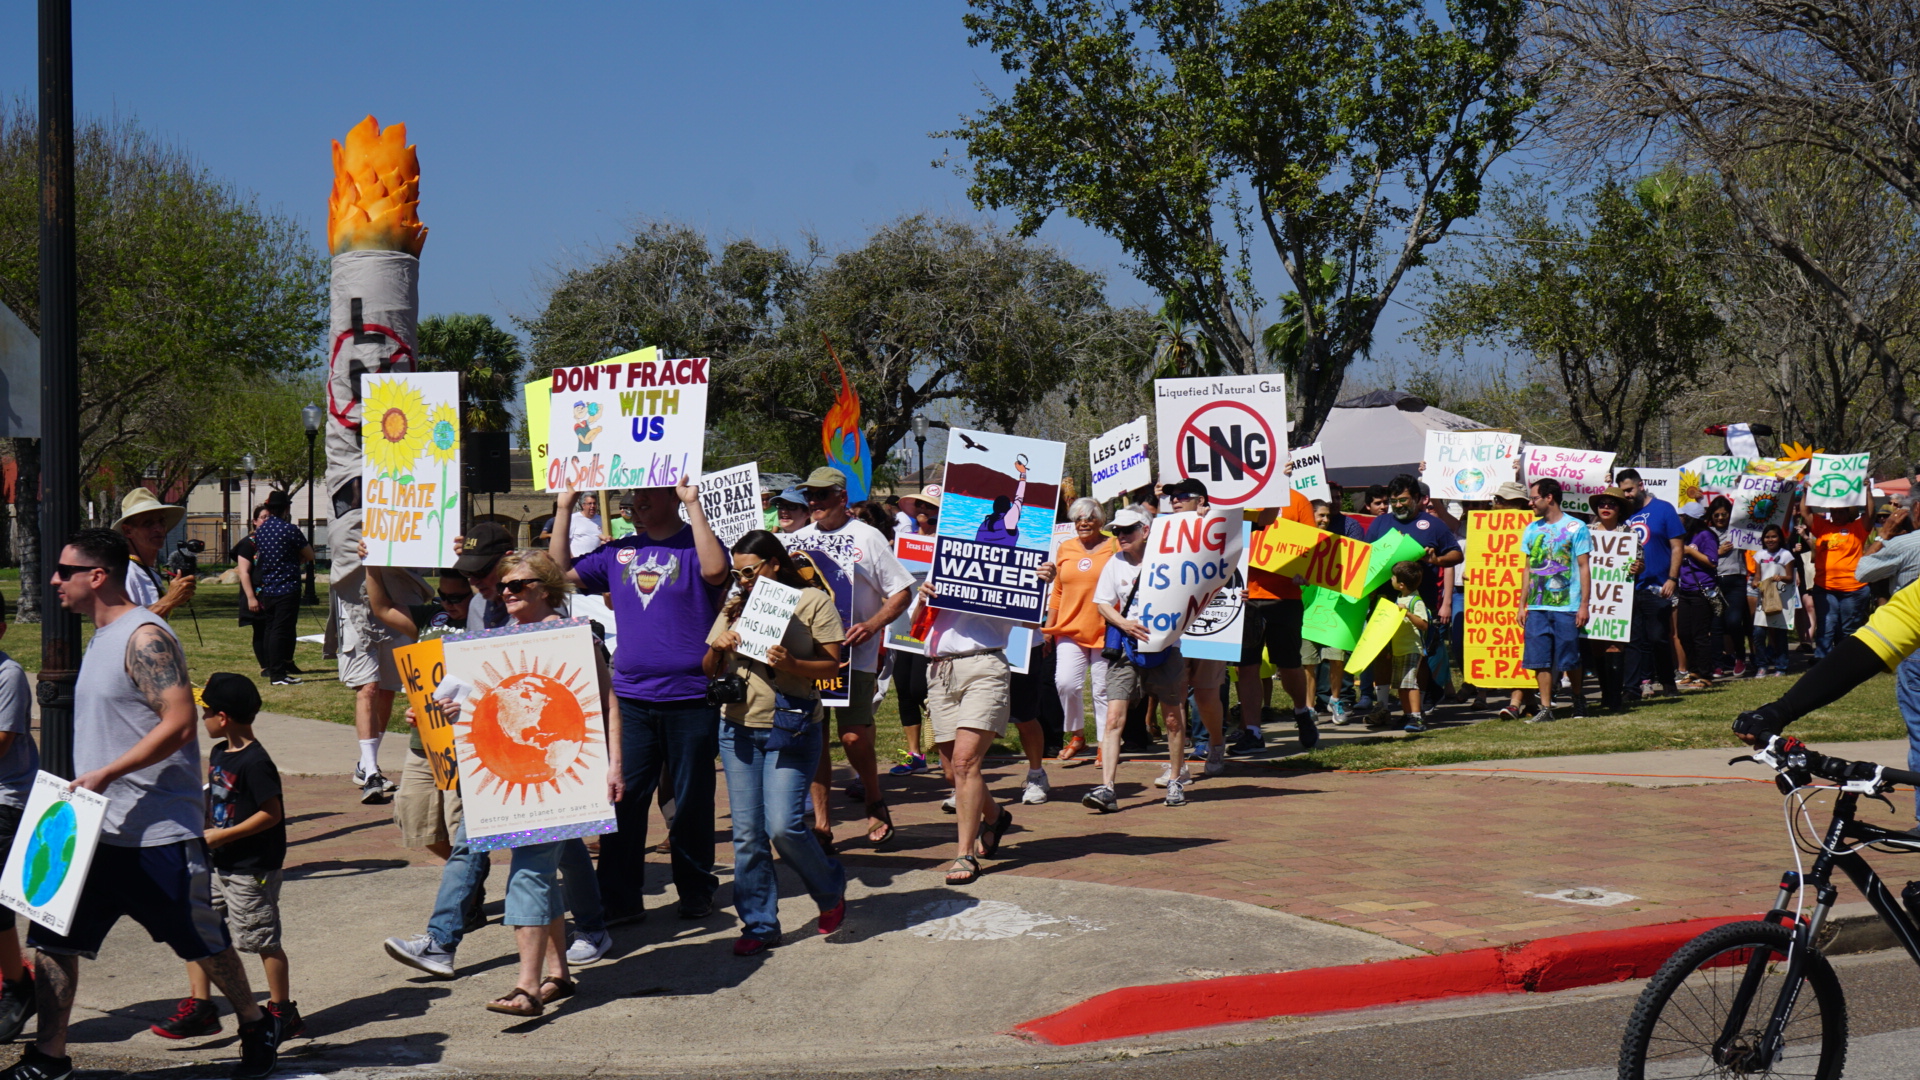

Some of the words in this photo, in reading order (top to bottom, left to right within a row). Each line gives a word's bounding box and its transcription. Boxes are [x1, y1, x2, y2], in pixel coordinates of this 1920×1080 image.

[552, 364, 621, 393] DON'T
[627, 359, 708, 387] FRACK
[1158, 385, 1209, 399] Liquefied
[1212, 383, 1255, 395] Natural
[1259, 381, 1281, 393] Gas
[620, 389, 679, 417] WITH
[632, 416, 664, 442] US
[1475, 433, 1483, 445] IS
[1494, 433, 1514, 444] NO
[1094, 444, 1116, 464] LESS
[1186, 424, 1267, 482] LNG
[1291, 453, 1320, 471] ARBON
[1438, 444, 1494, 462] PLANET
[1531, 449, 1547, 462] La
[1555, 453, 1587, 463] Salud
[1588, 454, 1603, 464] de
[550, 457, 567, 489] Oil
[1092, 463, 1119, 484] COOLER
[1121, 451, 1145, 471] EARTH
[1528, 462, 1586, 480] Nuestros
[699, 469, 752, 493] OLONIZE
[1295, 475, 1318, 490] LIFE
[1642, 479, 1667, 487] TUARY
[1700, 474, 1736, 488] LAKE
[1744, 479, 1794, 494] DEFEND
[367, 479, 436, 508] CLIMATE
[703, 491, 721, 508] NO
[724, 483, 754, 503] BAN
[705, 506, 721, 520] NO
[724, 498, 755, 516] WALL
[1561, 498, 1589, 512] ecio
[362, 511, 423, 542] JUSTICE
[711, 511, 755, 528] ATRIARCHY
[720, 522, 745, 537] STAND
[746, 519, 758, 531] UP
[1473, 513, 1533, 533] TURN
[1159, 517, 1227, 555] LNG
[1487, 534, 1518, 553] UP
[1730, 528, 1762, 547] Mothe
[906, 541, 921, 550] Texas
[922, 544, 933, 552] LNG
[941, 539, 1010, 564] PROTECT
[1014, 550, 1043, 568] THE
[1276, 542, 1287, 554] IN
[1289, 543, 1311, 558] THE
[1305, 532, 1370, 590] RGV
[1482, 553, 1519, 567] THE
[940, 557, 1039, 589] WATER
[1149, 562, 1170, 590] is
[1181, 558, 1229, 585] not
[760, 581, 783, 600] THIS
[782, 591, 800, 606] LAND
[935, 582, 978, 600] DEFEND
[982, 589, 1003, 604] THE
[1006, 594, 1039, 609] LAND
[1468, 588, 1525, 608] UNDE
[750, 597, 759, 611] IS
[760, 600, 777, 616] YOUR
[740, 617, 759, 632] THIS
[760, 624, 781, 639] LAND
[1139, 603, 1181, 634] for
[1467, 628, 1487, 644] TO
[1492, 627, 1525, 646] SAV
[754, 644, 769, 658] LAN
[1487, 646, 1520, 659] THE
[401, 654, 424, 695] We
[815, 677, 843, 691] ABLE
[480, 815, 509, 824] destroy
[513, 812, 526, 820] the
[529, 808, 554, 818] planet
[570, 804, 587, 812] save
